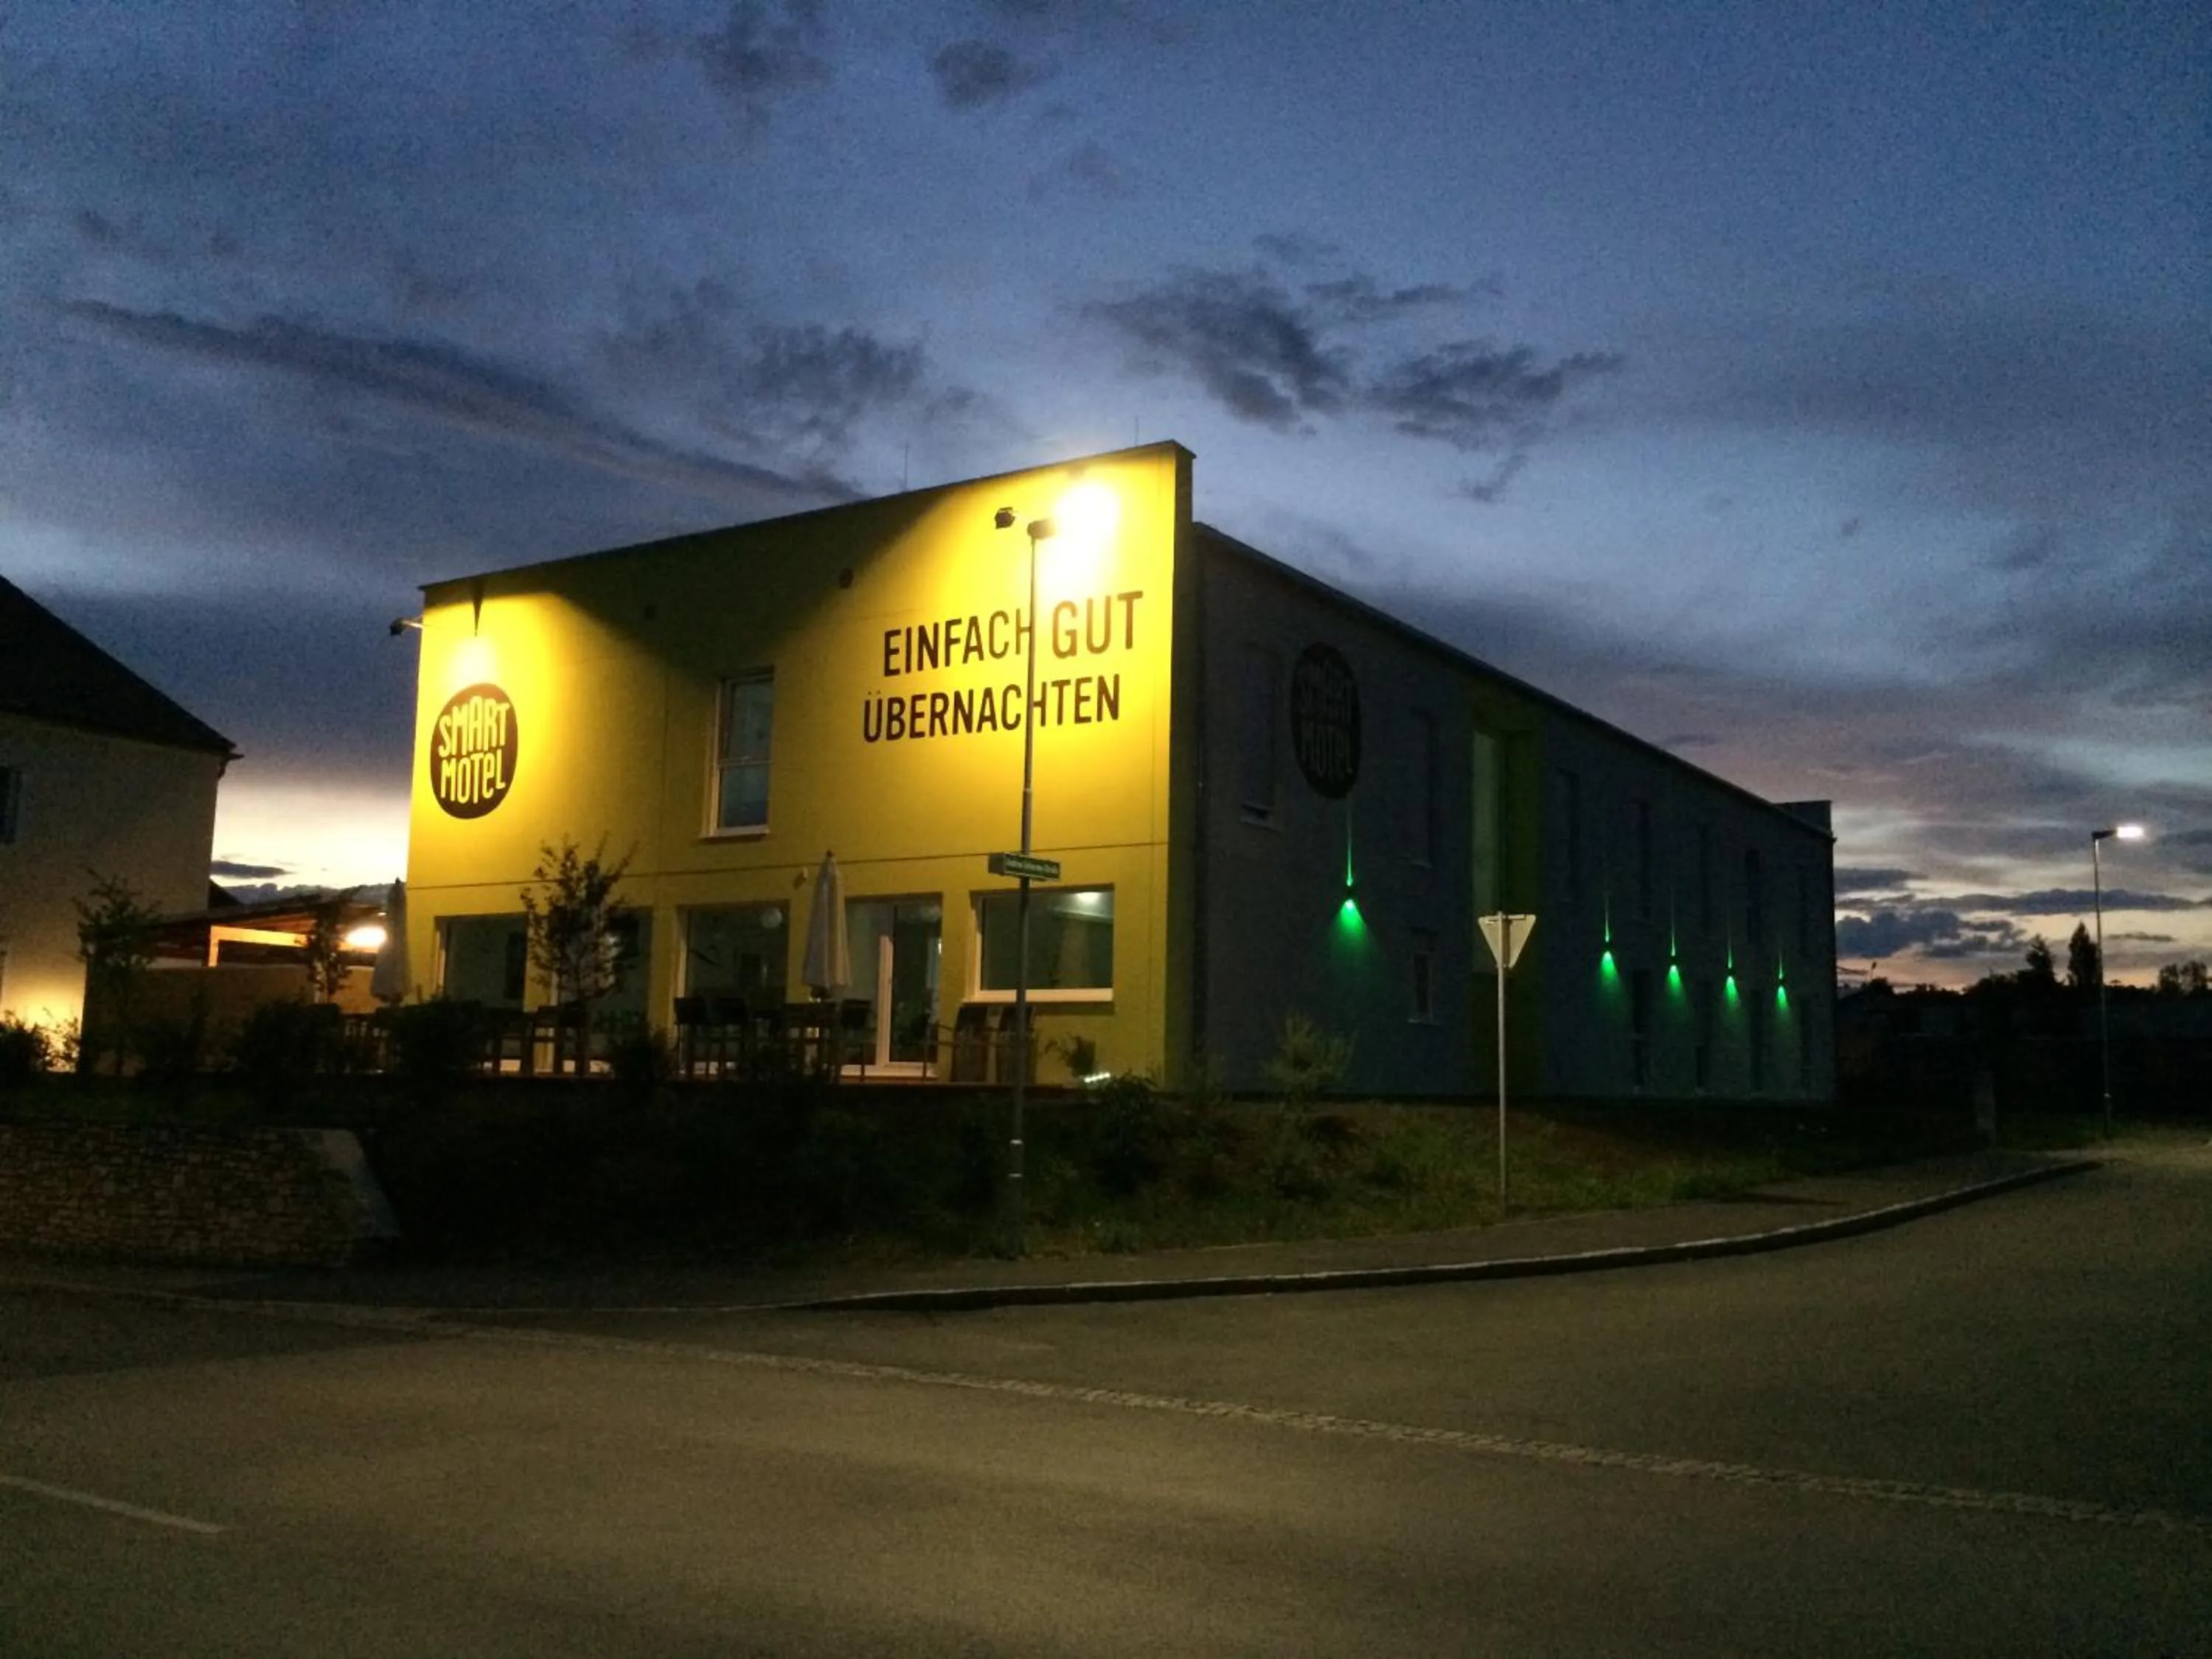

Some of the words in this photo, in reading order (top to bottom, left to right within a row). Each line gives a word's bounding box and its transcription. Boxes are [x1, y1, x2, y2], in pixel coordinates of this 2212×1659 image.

[884, 608, 1033, 677] EINFACH
[1052, 591, 1143, 658] GUT
[438, 695, 510, 757] SMART
[863, 674, 1120, 743] ÜBERNACHTEN
